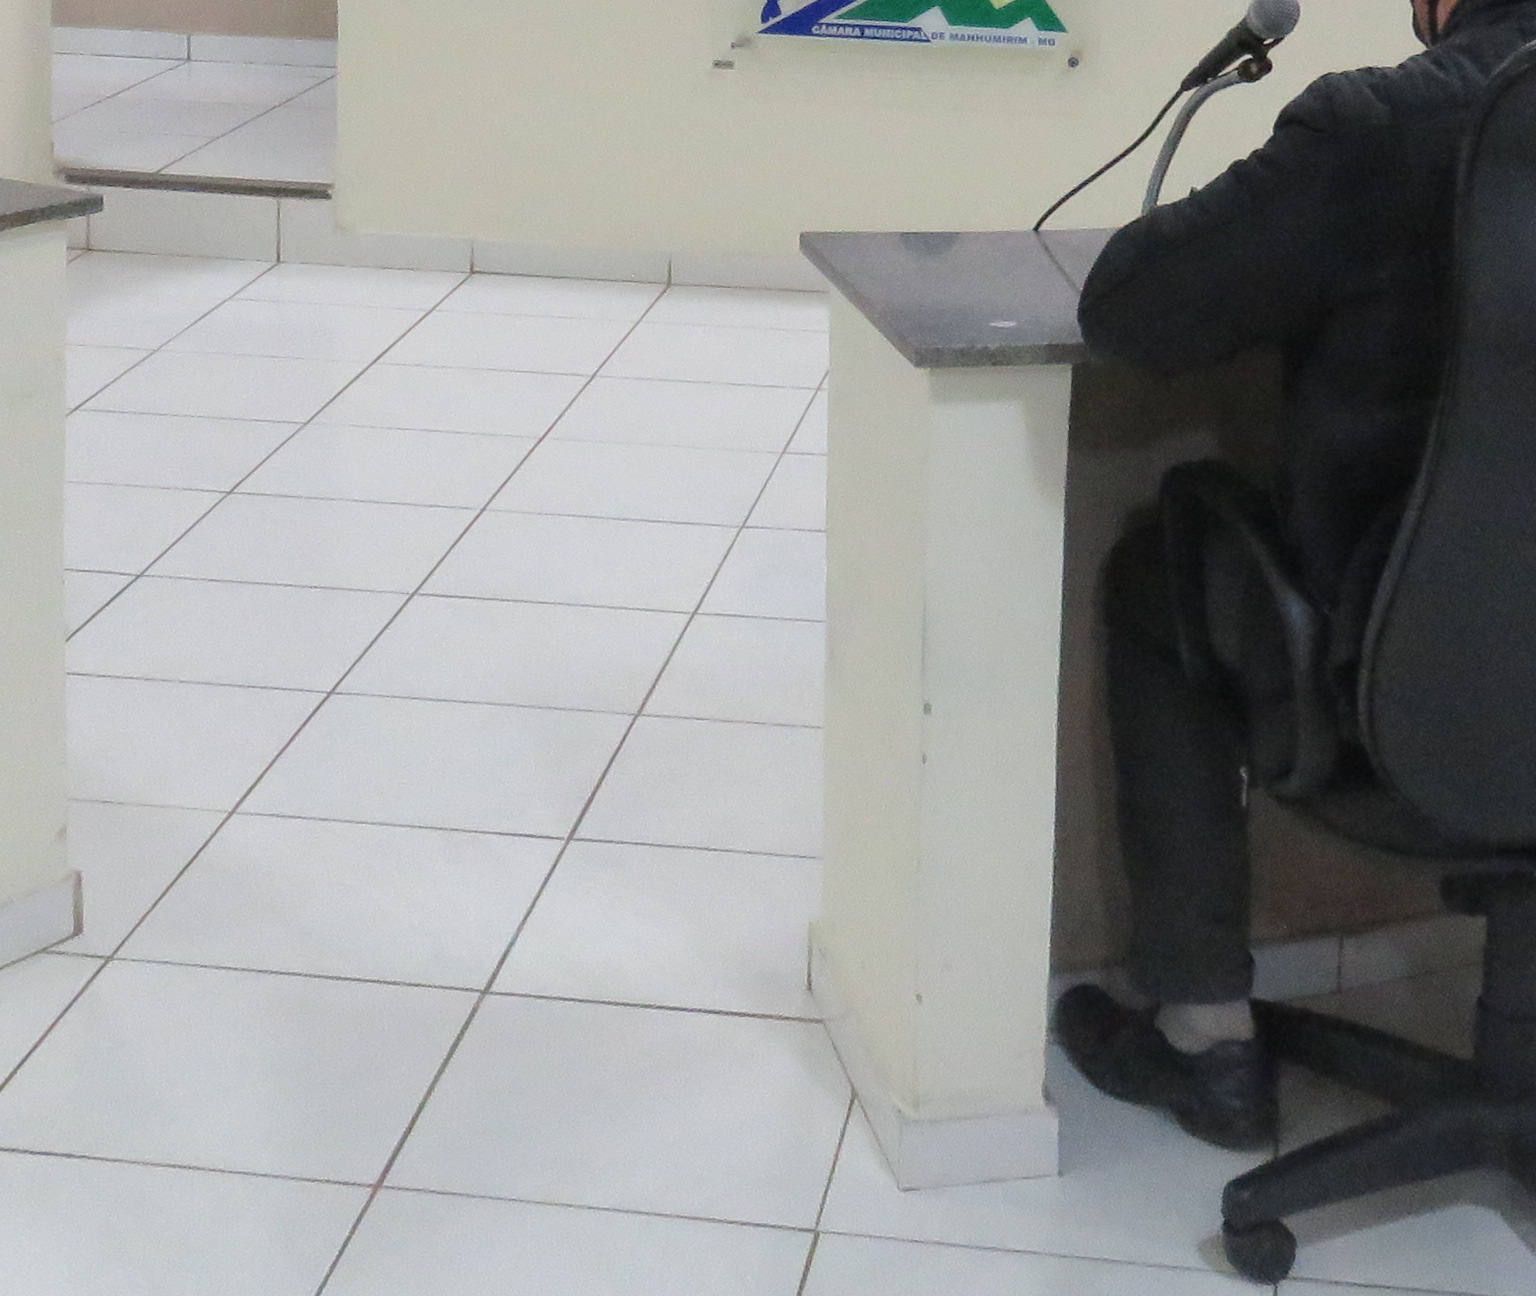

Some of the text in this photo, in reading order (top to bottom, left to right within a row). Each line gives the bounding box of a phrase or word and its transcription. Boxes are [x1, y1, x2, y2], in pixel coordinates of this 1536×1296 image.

[863, 27, 928, 41] MUNICIPAL
[931, 32, 945, 41] DE
[949, 33, 1028, 44] MANHUMIRIM
